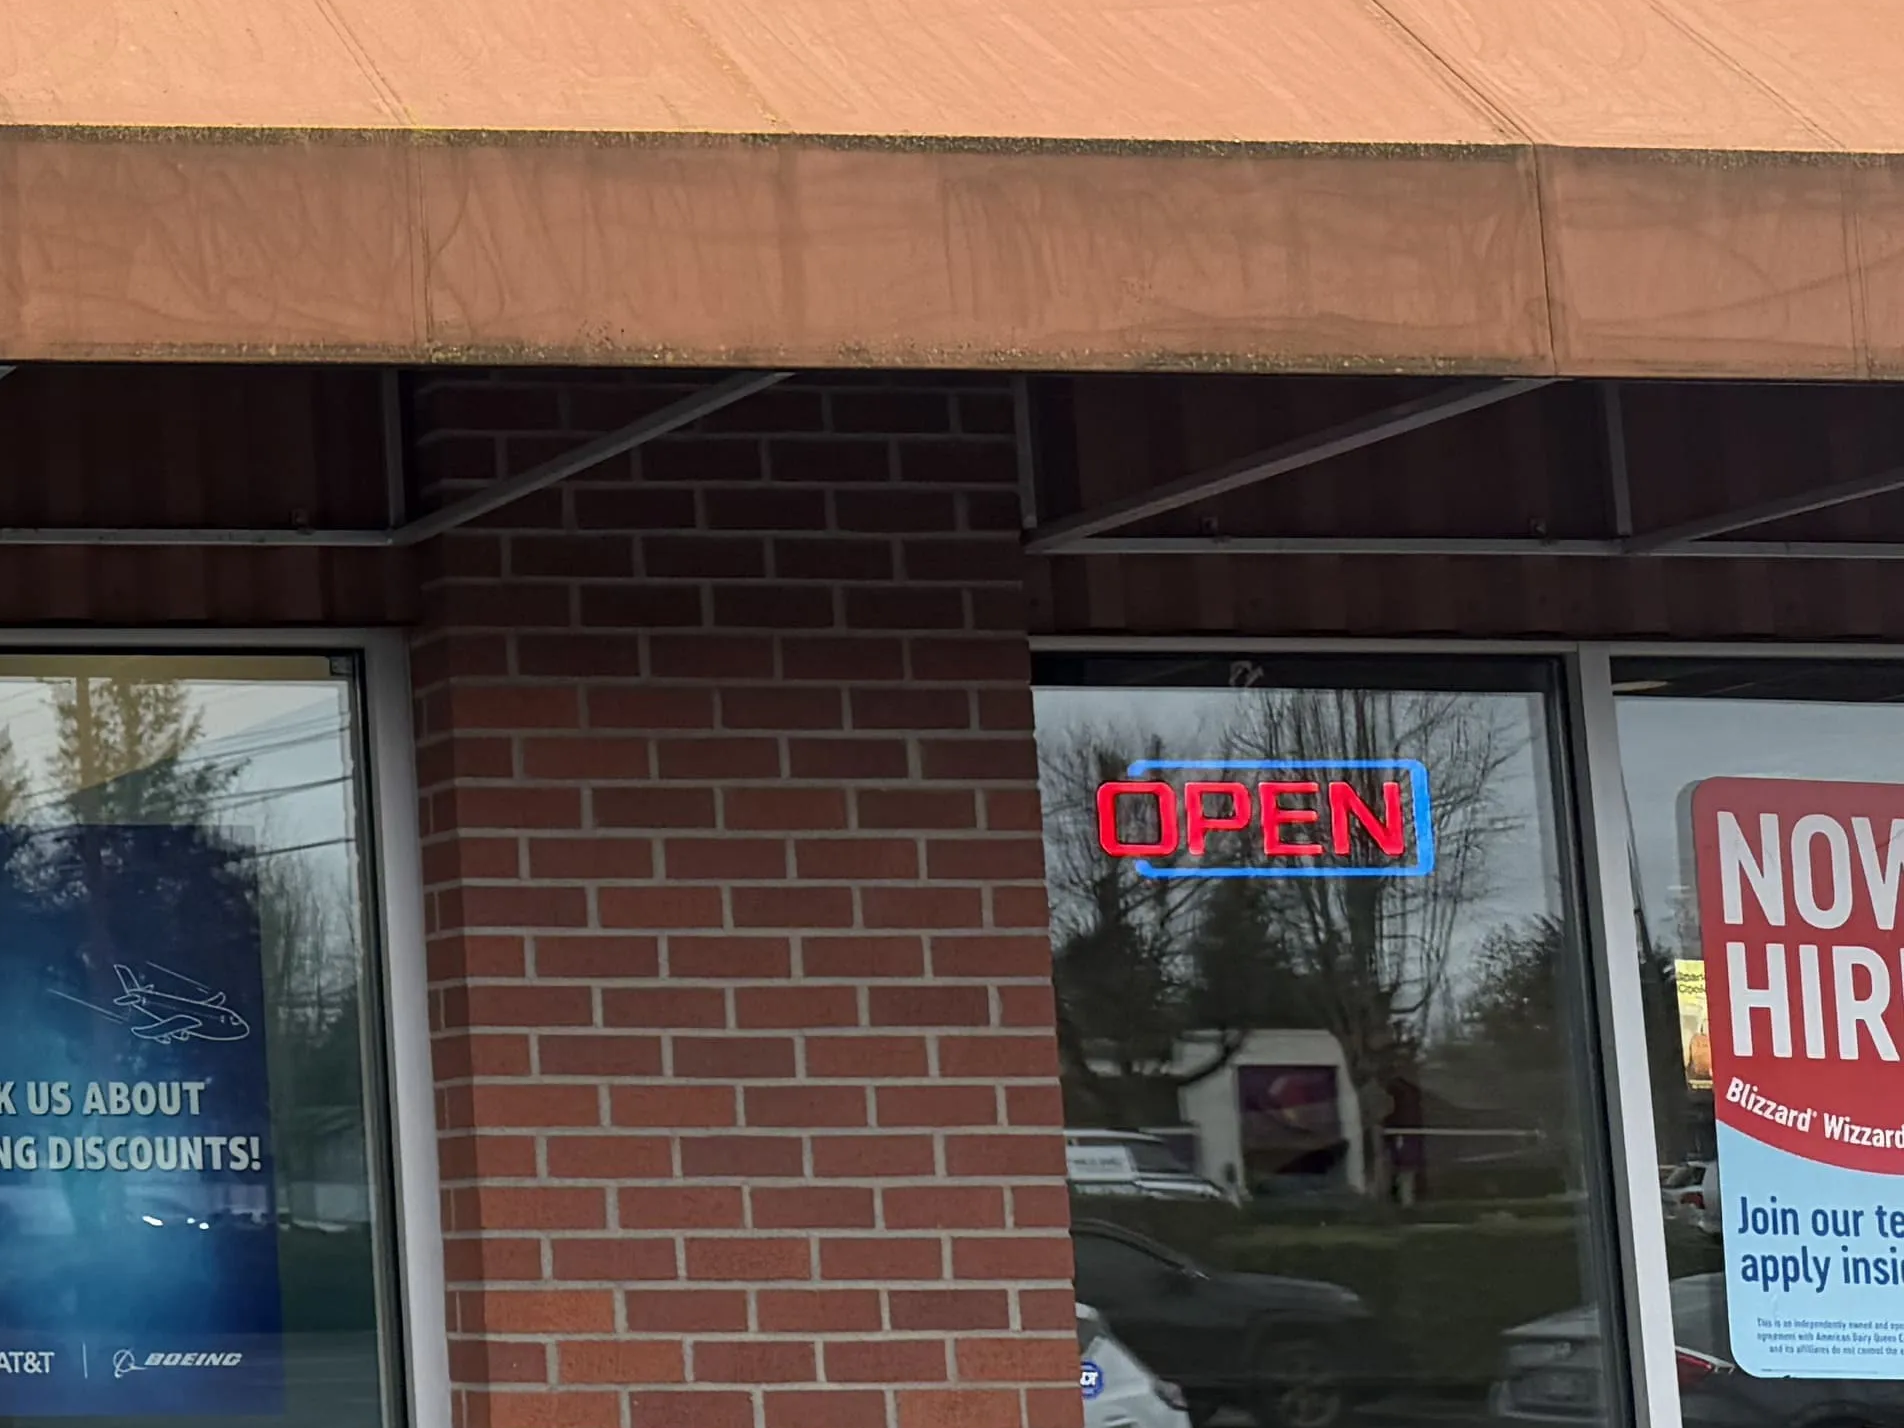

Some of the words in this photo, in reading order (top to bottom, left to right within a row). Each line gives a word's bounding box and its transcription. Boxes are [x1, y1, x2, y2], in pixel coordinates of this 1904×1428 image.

[1096, 780, 1405, 857] OPEN
[1725, 940, 1904, 1062] HIR
[26, 1080, 73, 1116] US
[81, 1080, 207, 1116] ABOUT
[48, 1135, 263, 1172] DISCOUNTS!
[1737, 1195, 1800, 1236] Join
[1810, 1208, 1865, 1238] our
[1740, 1245, 1832, 1293] apply
[1841, 1244, 1904, 1286] insi
[144, 1352, 243, 1367] BOEING
